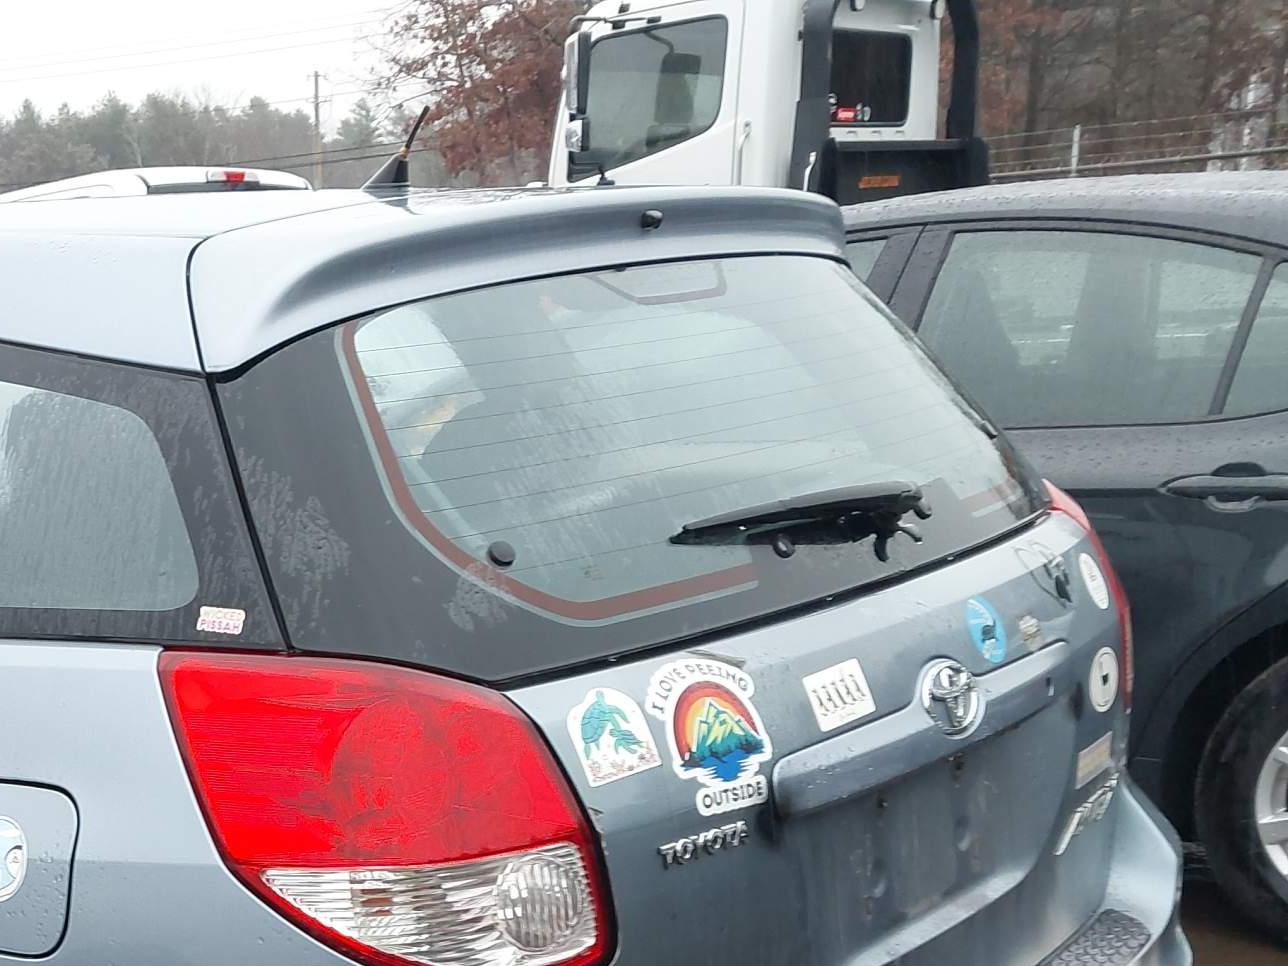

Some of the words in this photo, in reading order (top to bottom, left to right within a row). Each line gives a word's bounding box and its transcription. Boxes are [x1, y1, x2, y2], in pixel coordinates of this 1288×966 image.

[200, 619, 241, 633] PISSAH
[658, 667, 686, 702] LOVE
[689, 663, 749, 693] PEEING
[652, 702, 665, 714] I
[702, 780, 765, 809] OUTSIDE
